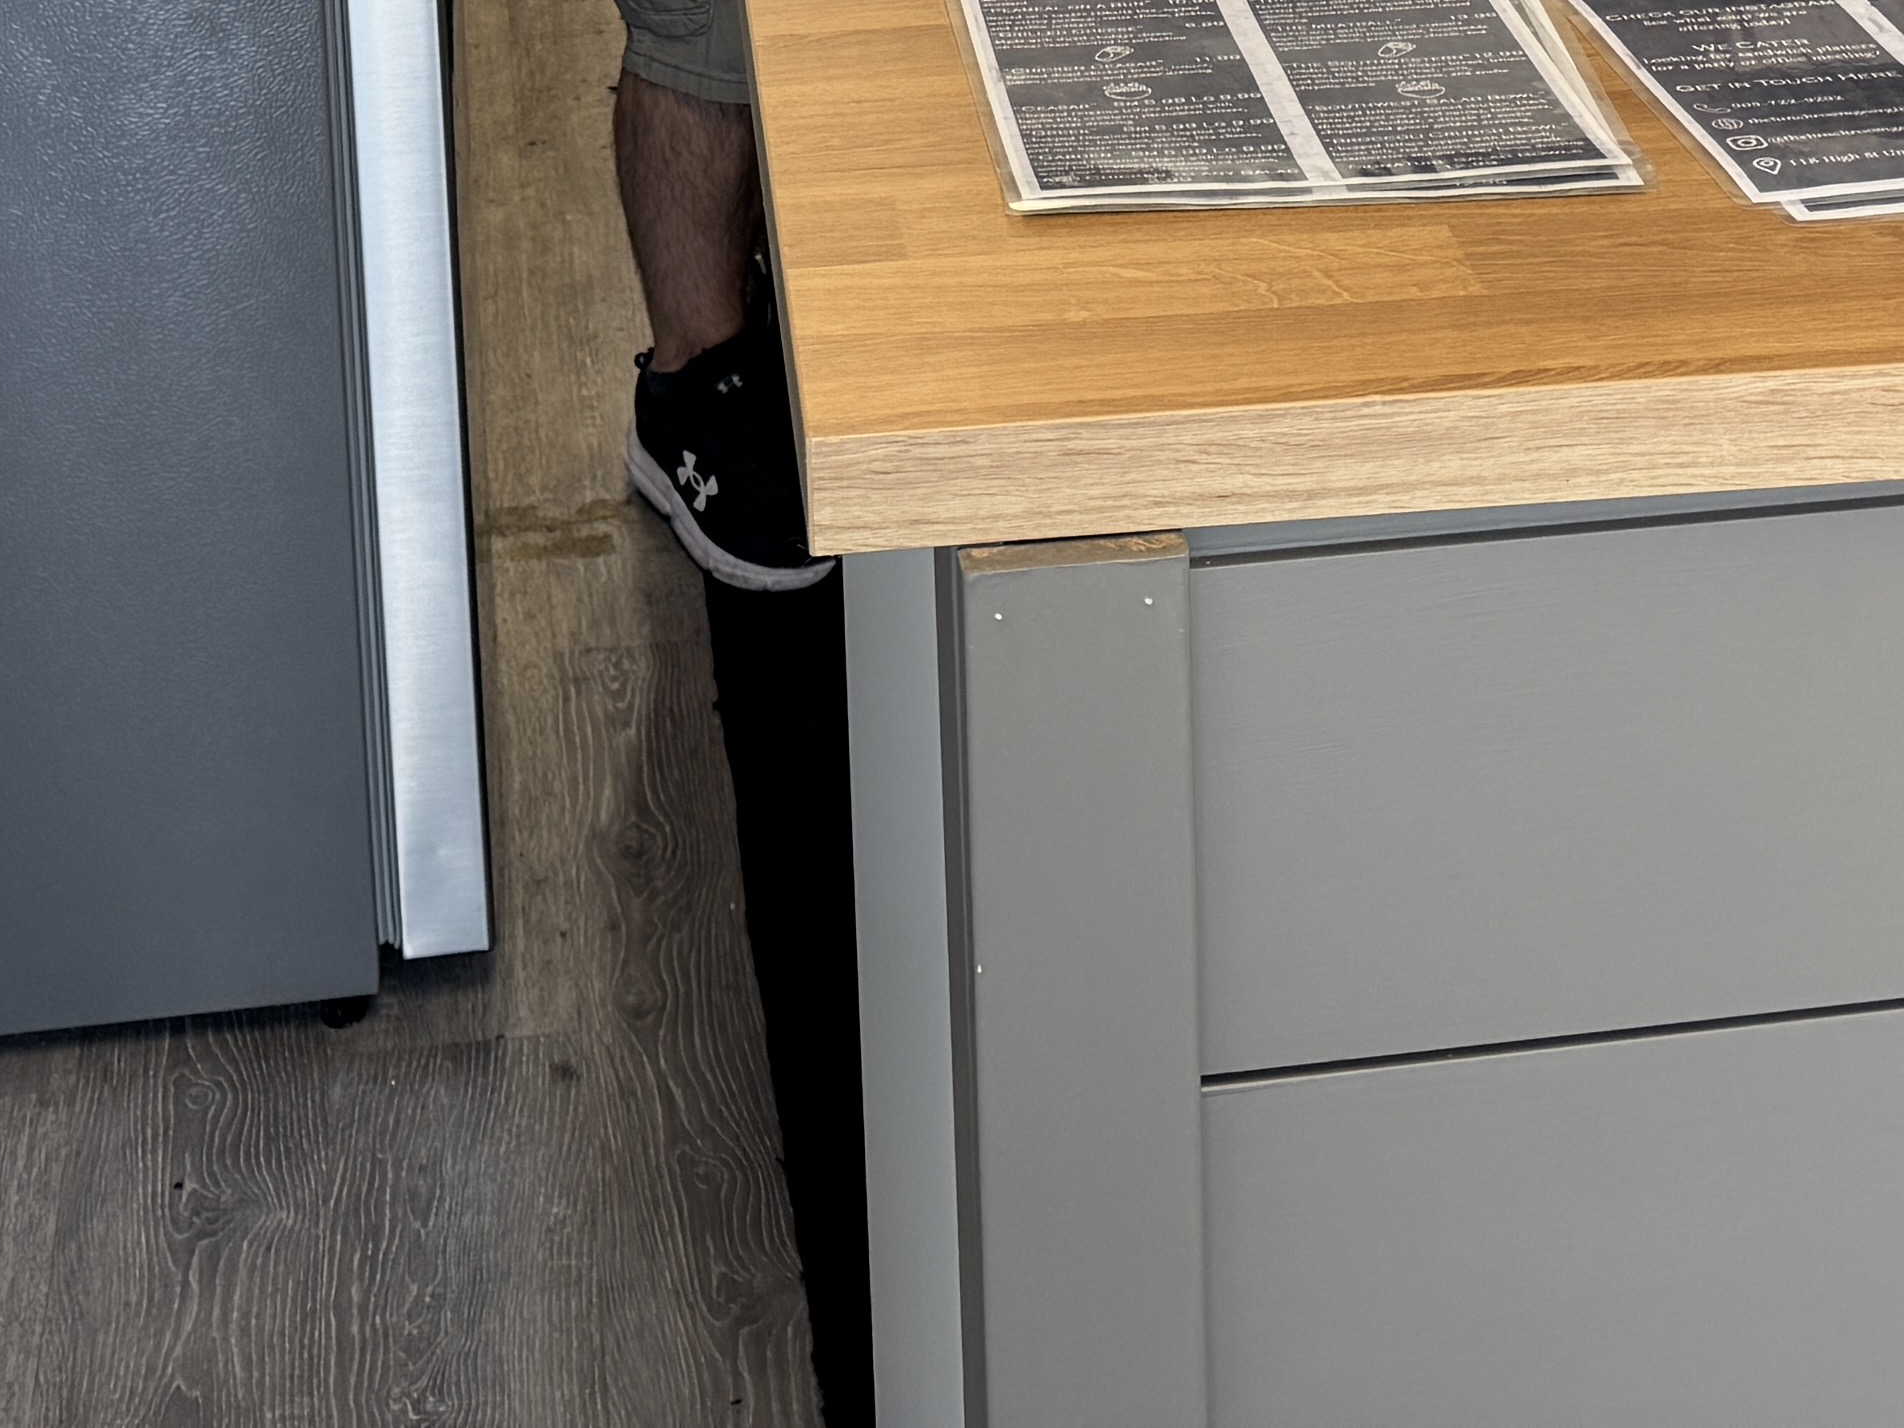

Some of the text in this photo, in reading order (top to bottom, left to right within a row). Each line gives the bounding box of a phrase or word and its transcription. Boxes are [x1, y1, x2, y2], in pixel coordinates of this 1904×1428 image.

[1606, 0, 1836, 21] CHECK OUR INSTAGRAM
[1692, 38, 1810, 51] WE CATER
[1676, 70, 1904, 93] GET IN TOUCH HERE
